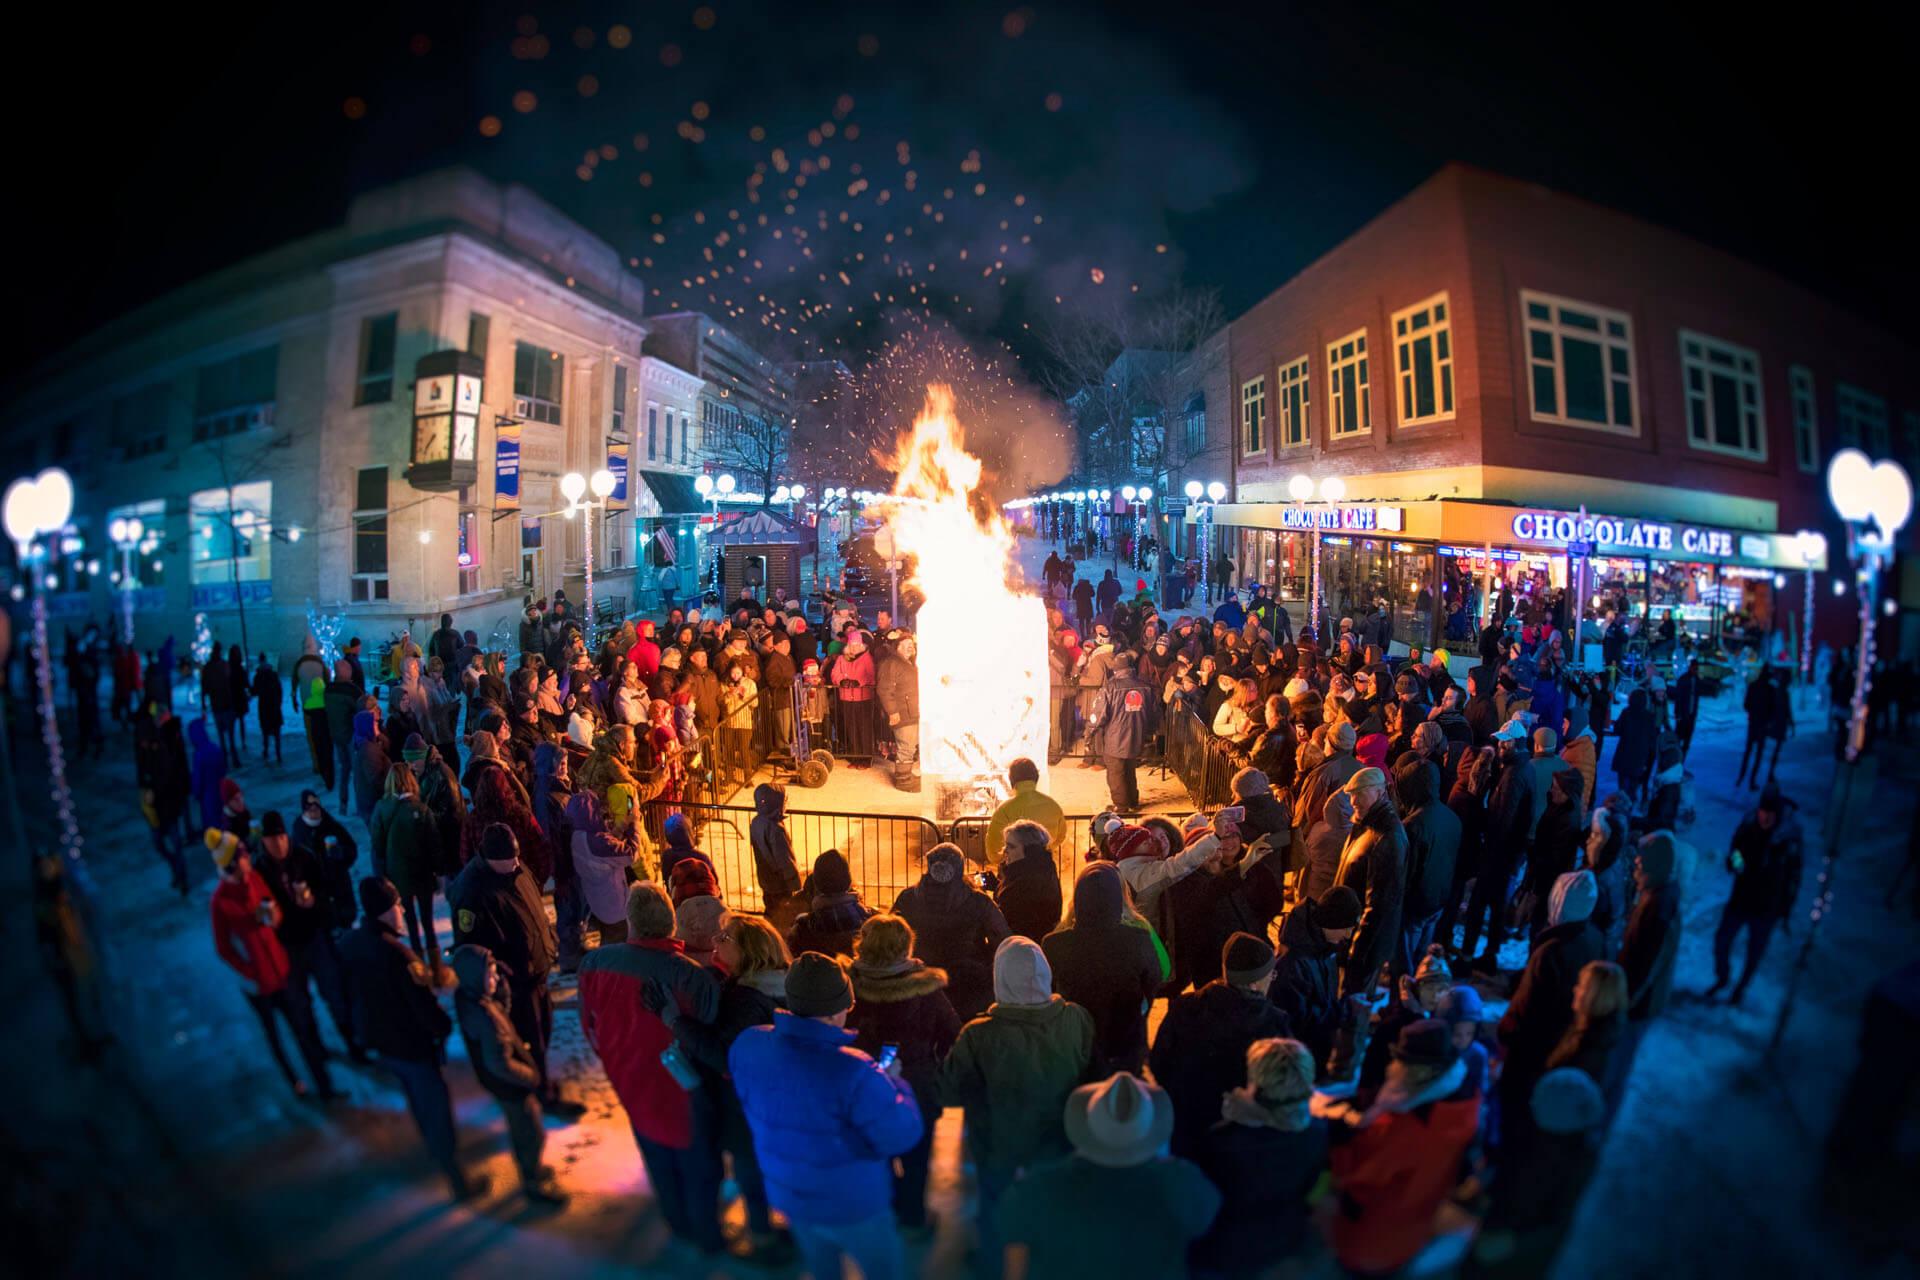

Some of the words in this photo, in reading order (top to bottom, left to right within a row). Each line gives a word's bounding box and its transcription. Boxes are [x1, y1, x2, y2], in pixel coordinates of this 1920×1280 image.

[1282, 508, 1341, 529] CHOCOATE
[1344, 508, 1375, 530] CAFE
[1513, 513, 1672, 550] CHOCOLATE
[1682, 528, 1733, 557] CAFE
